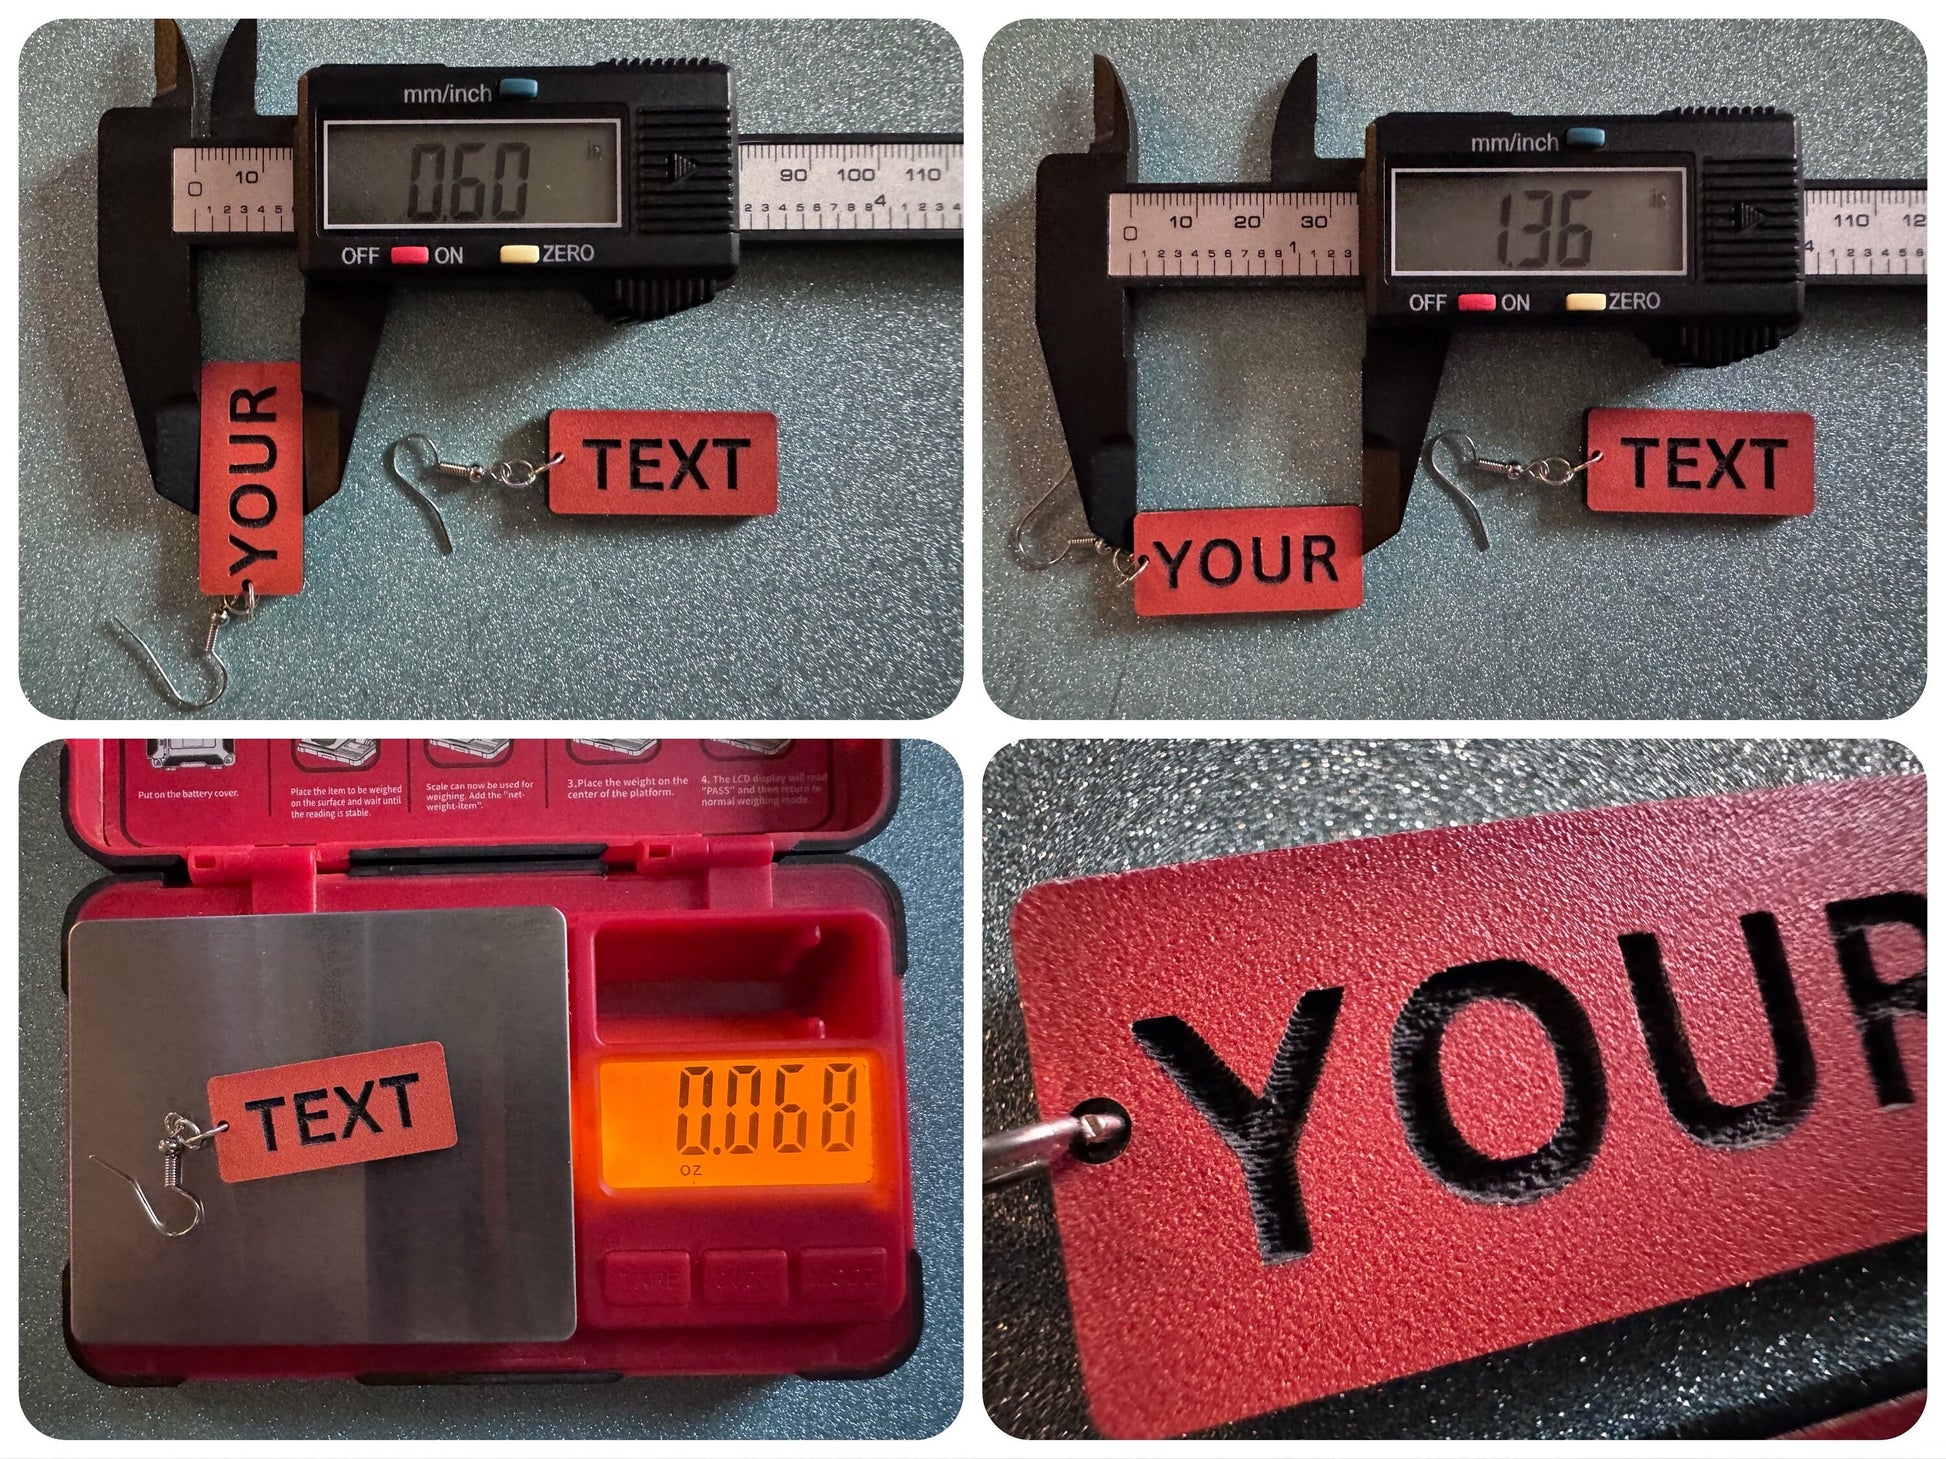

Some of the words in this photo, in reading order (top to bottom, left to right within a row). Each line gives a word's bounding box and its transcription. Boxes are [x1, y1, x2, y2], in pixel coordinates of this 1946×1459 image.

[404, 84, 492, 104] mm/inch
[1472, 133, 1559, 152] mm/inch
[236, 172, 258, 183] 10
[780, 169, 807, 181] 90
[837, 169, 875, 181] 100
[905, 169, 941, 181] 110
[188, 182, 202, 196] 0
[874, 195, 886, 207] 4
[744, 204, 752, 212] 2
[761, 204, 769, 212] 3
[779, 204, 786, 212] 4
[796, 204, 804, 212] 5
[813, 204, 821, 212] 6
[831, 204, 837, 212] 7
[848, 204, 855, 212] 8
[865, 204, 872, 212] 9
[902, 203, 907, 212] 1
[919, 203, 926, 212] 2
[936, 203, 943, 212] 3
[953, 203, 961, 212] 4
[1170, 216, 1192, 228] 10
[1234, 216, 1260, 228] 20
[1301, 216, 1327, 228] 30
[1834, 215, 1869, 226] 110
[1123, 226, 1137, 240] 0
[1290, 242, 1296, 253] 1
[1804, 240, 1814, 252] 4
[342, 248, 379, 265] OFF
[434, 248, 463, 264] ON
[543, 244, 594, 263] ZERO
[1142, 250, 1146, 258] 1
[1158, 250, 1165, 258] 2
[1175, 250, 1181, 258] 3
[1192, 250, 1198, 258] 4
[1208, 250, 1215, 258] 5
[1225, 250, 1232, 258] 6
[1242, 250, 1248, 258] 7
[1258, 250, 1265, 258] 8
[1275, 250, 1282, 258] 9
[1830, 249, 1835, 257] 1
[1847, 249, 1854, 257] 2
[1864, 249, 1871, 257] 3
[1882, 249, 1889, 257] 4
[1899, 249, 1907, 257] 5
[1916, 249, 1924, 257] 6
[1410, 294, 1447, 311] OFF
[1502, 294, 1530, 311] ON
[1609, 292, 1660, 310] ZERO
[582, 438, 751, 491] TEXT
[1620, 437, 1788, 490] TEXT
[229, 386, 278, 577] YOUR
[1152, 534, 1339, 589] YOUR
[487, 781, 497, 789] be
[521, 780, 534, 788] for
[605, 778, 621, 786] the
[623, 777, 656, 787] weight
[701, 776, 710, 784] 4.
[713, 775, 730, 783] The
[732, 775, 750, 783] LCD
[138, 791, 153, 799] Put
[182, 790, 212, 798] battery
[313, 787, 326, 795] the
[328, 787, 345, 795] item
[358, 786, 367, 794] be
[369, 785, 402, 795] weighed
[568, 791, 597, 799] center
[600, 789, 610, 798] of
[612, 789, 627, 797] the
[630, 788, 674, 798] platform.
[738, 786, 755, 794] and
[318, 798, 345, 806] surface
[347, 797, 362, 805] and
[364, 797, 381, 805] wait
[383, 796, 401, 804] until
[426, 793, 466, 802] weighing.
[702, 797, 735, 806] normal
[737, 796, 779, 807] weighing
[306, 809, 335, 819] reading
[337, 809, 343, 817] is
[345, 809, 371, 817] stable.
[244, 1072, 419, 1152] TEXT
[677, 1063, 857, 1155] 0.068
